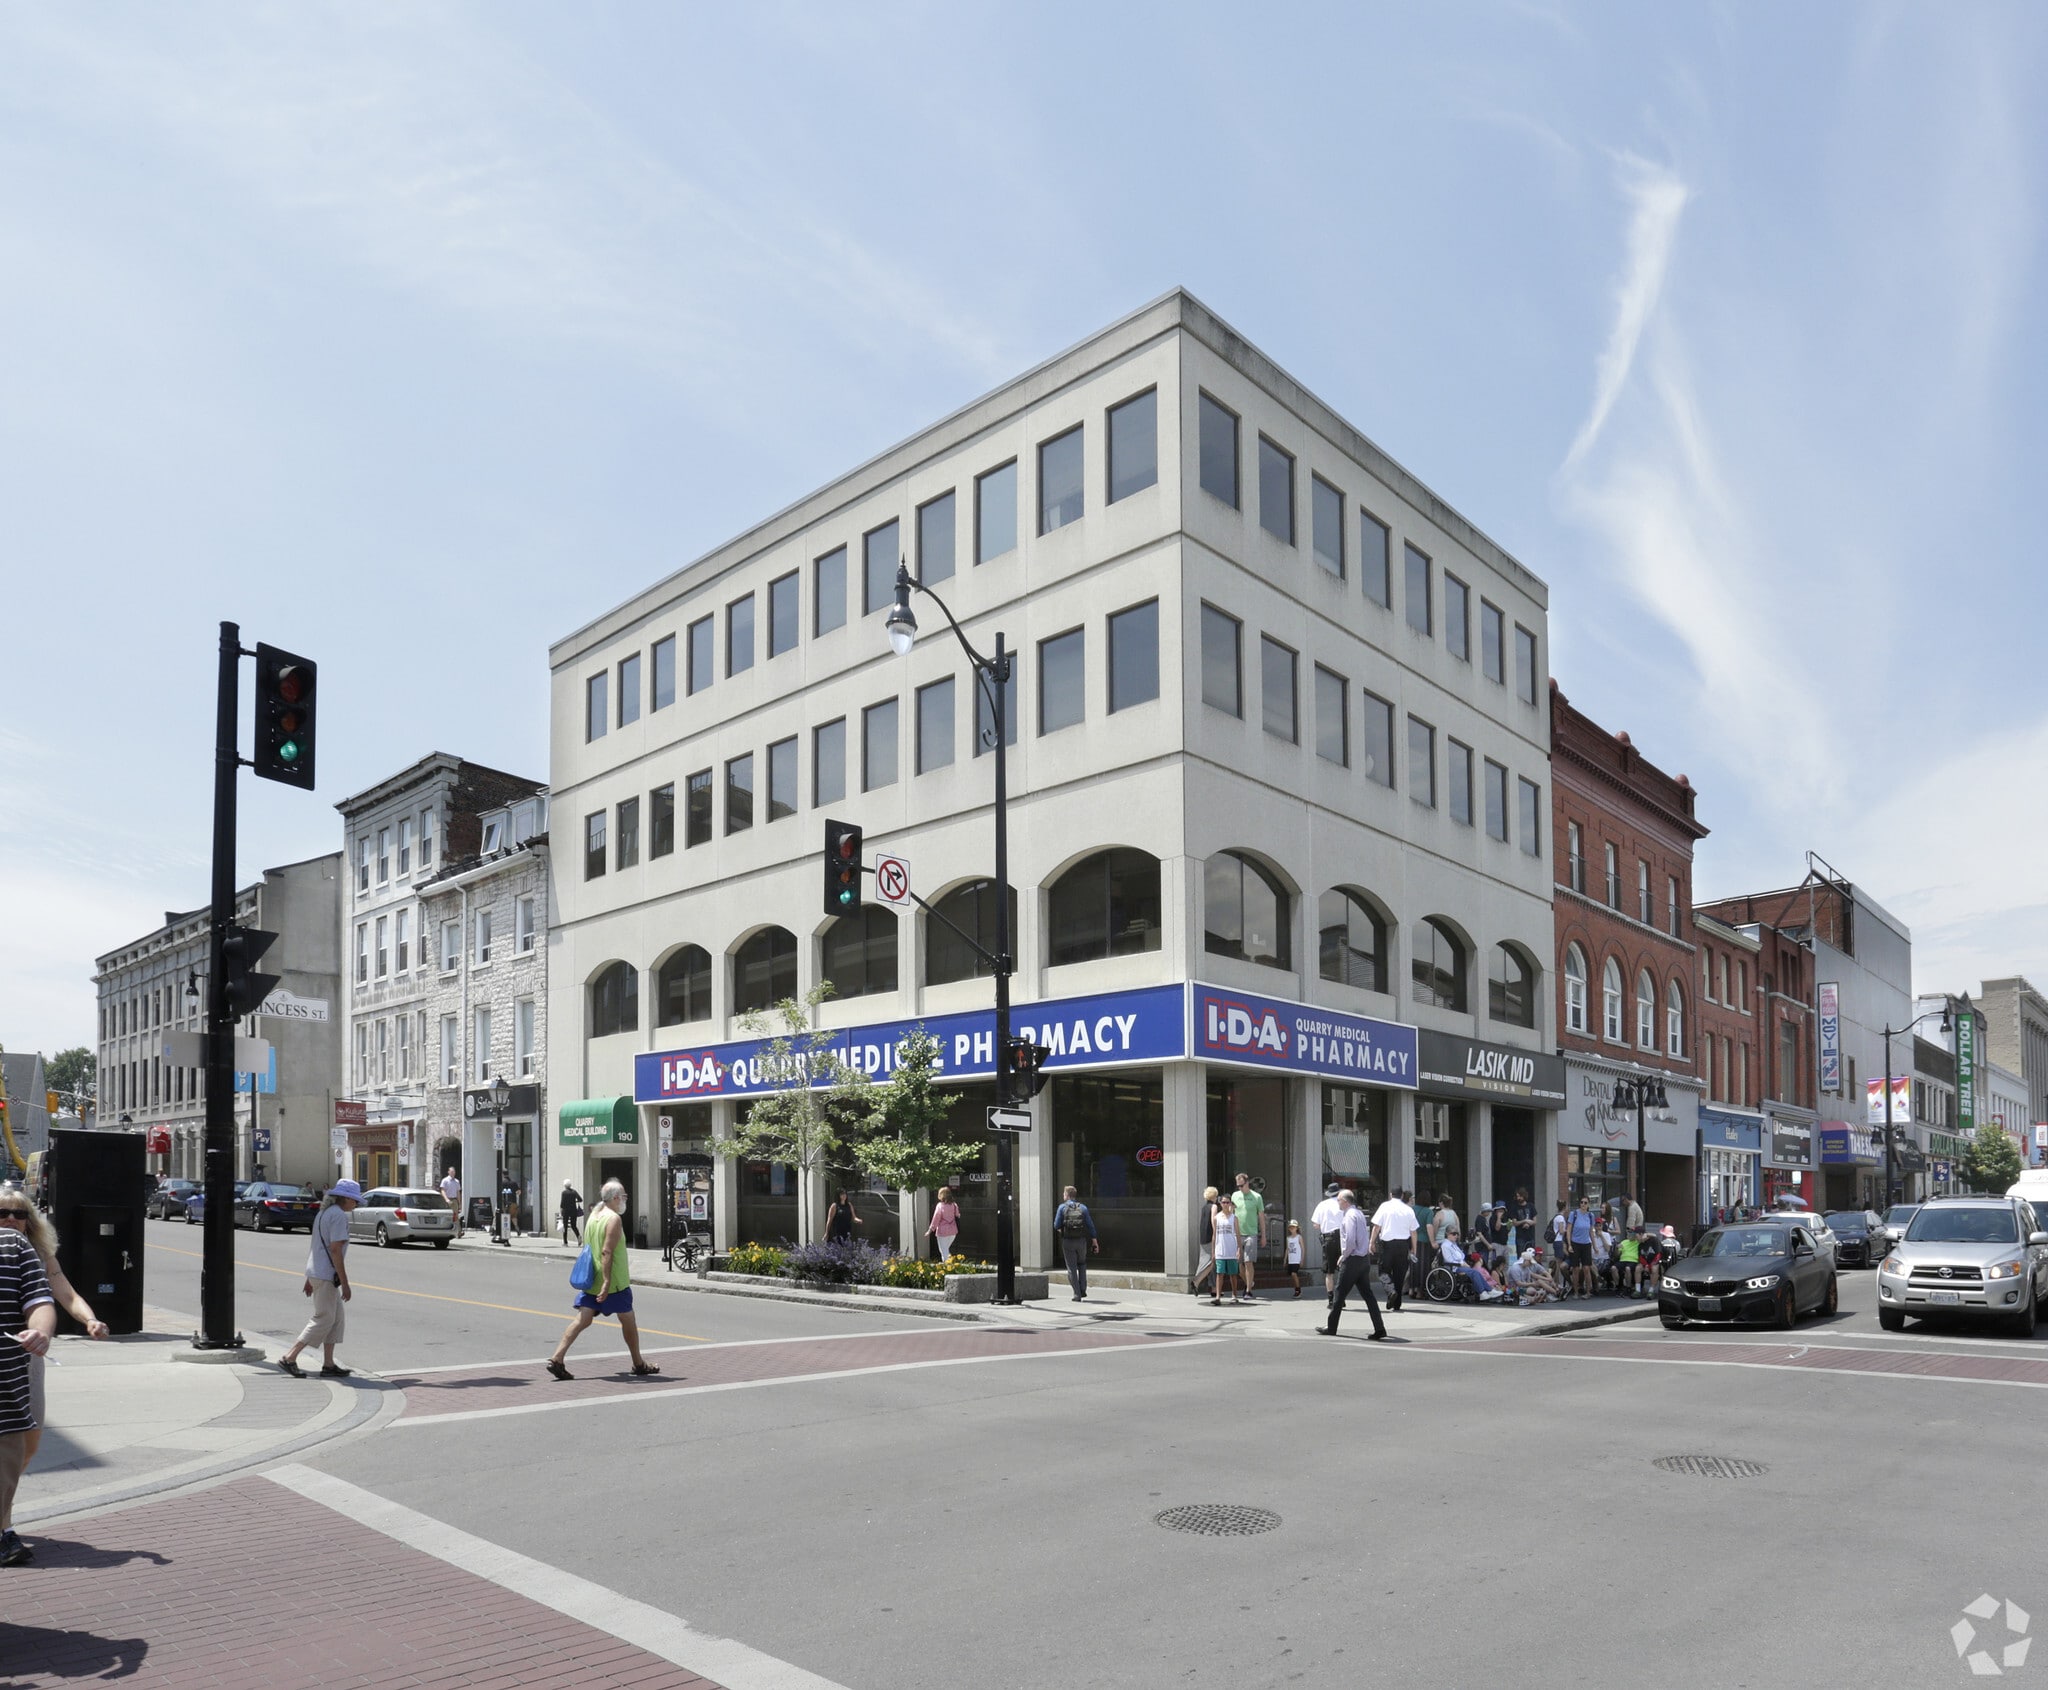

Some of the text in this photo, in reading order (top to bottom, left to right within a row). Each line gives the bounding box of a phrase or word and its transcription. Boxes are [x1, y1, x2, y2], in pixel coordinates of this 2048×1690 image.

[254, 1001, 327, 1020] INCESS ST.
[1295, 1017, 1371, 1043] QUARRY MEDICAL
[829, 1036, 945, 1079] MEDICL
[954, 1013, 1138, 1066] PHRMACY
[1297, 1034, 1409, 1076] PHARMACY
[1466, 1047, 1534, 1084] LASIK MD
[1958, 1020, 1972, 1117] DOLLAR TREE
[1482, 1081, 1516, 1093] VISION
[1583, 1075, 1612, 1100] DENTAL
[564, 1126, 607, 1137] MEDICAL BUILDING
[575, 1117, 595, 1127] QUARRY
[617, 1132, 633, 1142] 190
